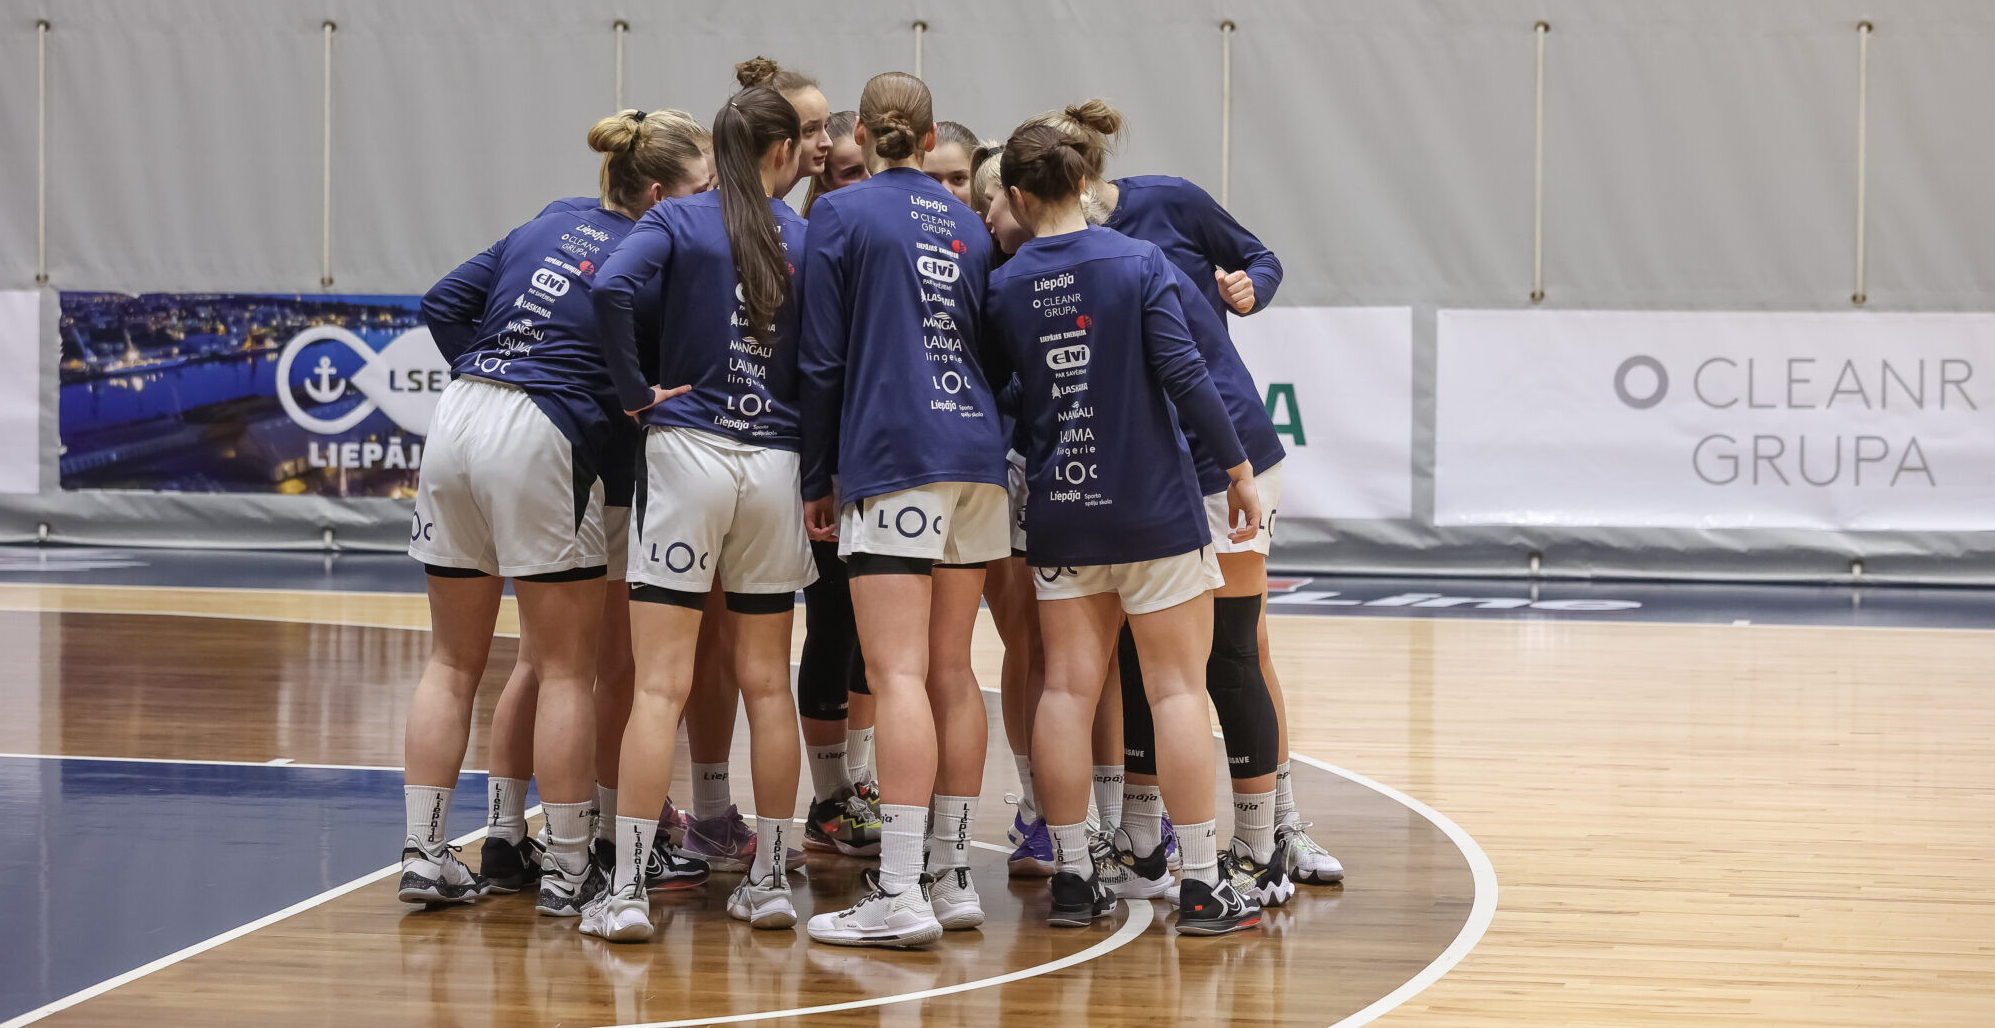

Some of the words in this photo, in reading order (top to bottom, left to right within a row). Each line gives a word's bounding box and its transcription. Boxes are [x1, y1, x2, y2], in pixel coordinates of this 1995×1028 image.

[920, 213, 957, 229] CLEANR
[921, 223, 953, 237] GRUPA
[562, 243, 588, 258] GRUPA
[568, 236, 600, 254] CLEANR
[1034, 273, 1075, 292] Liepāja
[522, 300, 552, 319] LASKANA
[1043, 293, 1082, 307] CLEANR
[1044, 305, 1078, 318] GRUPA
[729, 358, 766, 380] LAUMA
[389, 370, 451, 392] LSE
[1693, 357, 1979, 411] CLEANR
[727, 394, 772, 417] LOC
[1692, 433, 1937, 488] GRUPA
[1055, 461, 1098, 485] LOC
[1050, 489, 1081, 503] Liepāja
[877, 506, 943, 539] LOC
[650, 541, 708, 574] LOC
